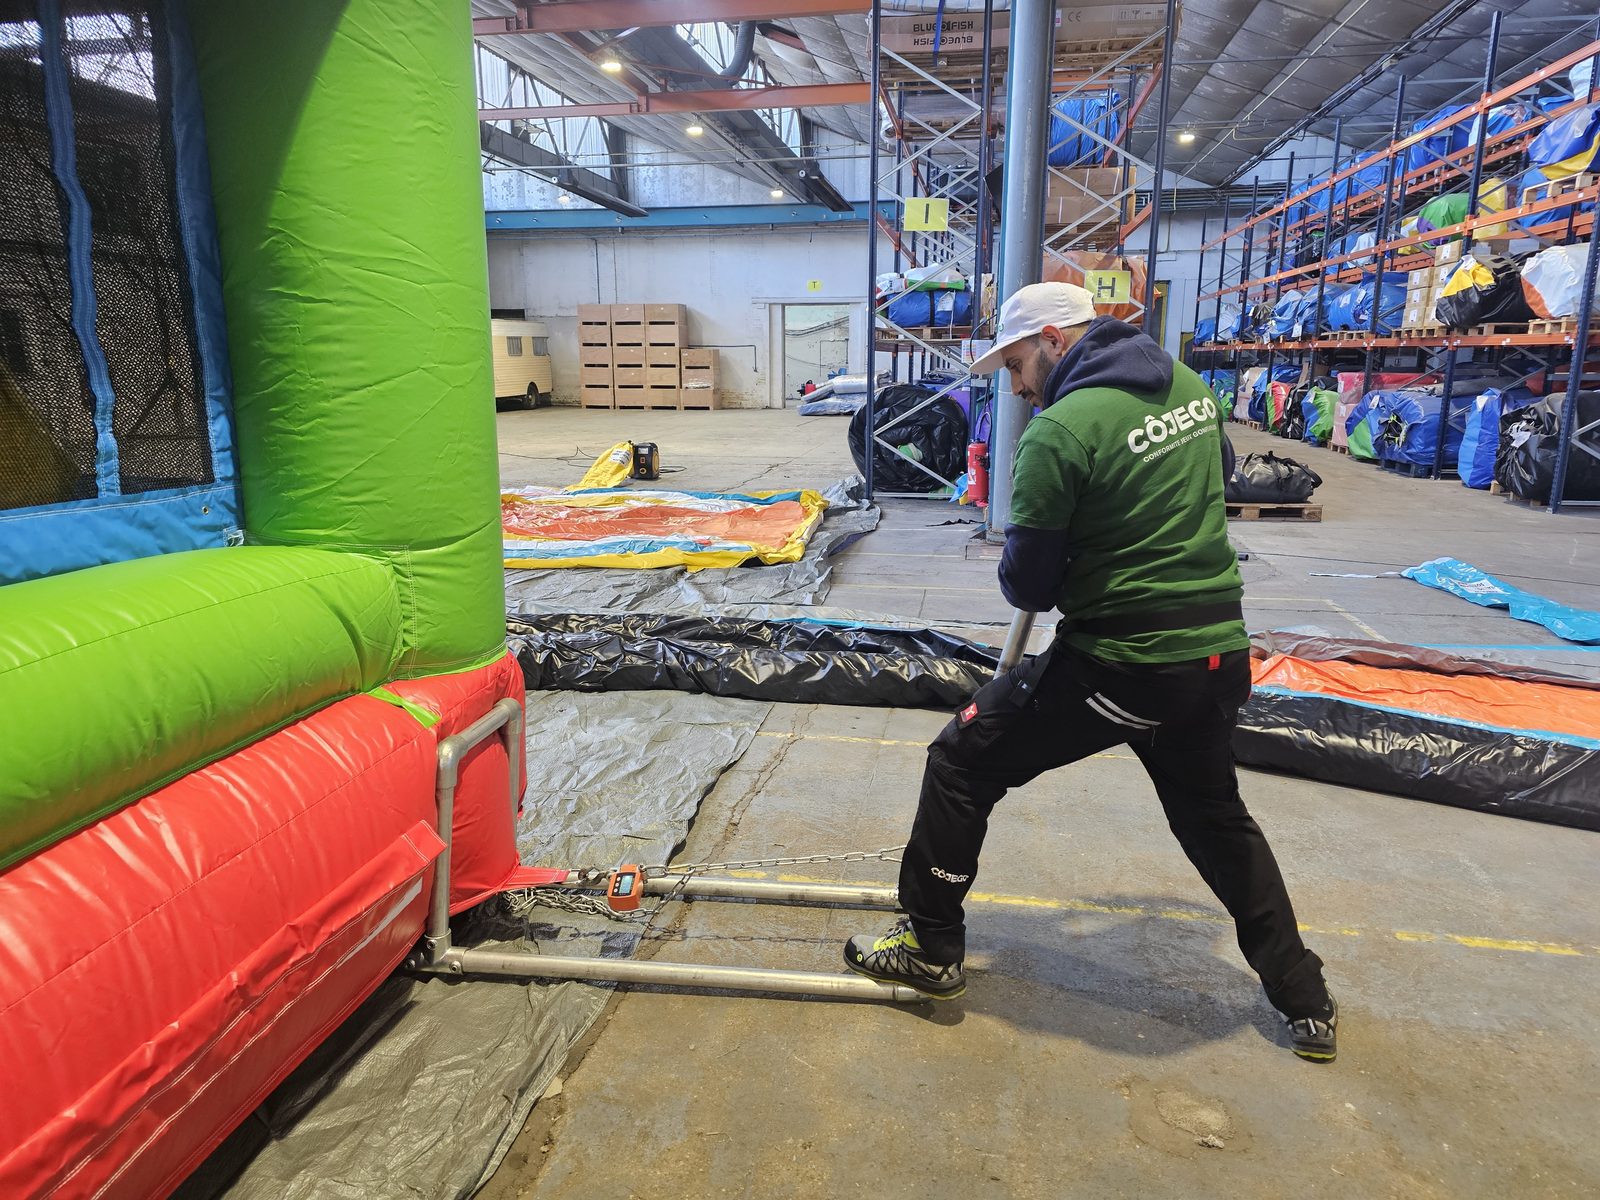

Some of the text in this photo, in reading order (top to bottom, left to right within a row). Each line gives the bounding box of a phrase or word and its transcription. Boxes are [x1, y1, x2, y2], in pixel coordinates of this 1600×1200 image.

[951, 21, 974, 30] FISH
[811, 280, 818, 289] T
[1097, 277, 1116, 297] H
[1127, 396, 1217, 454] CÔJEGO
